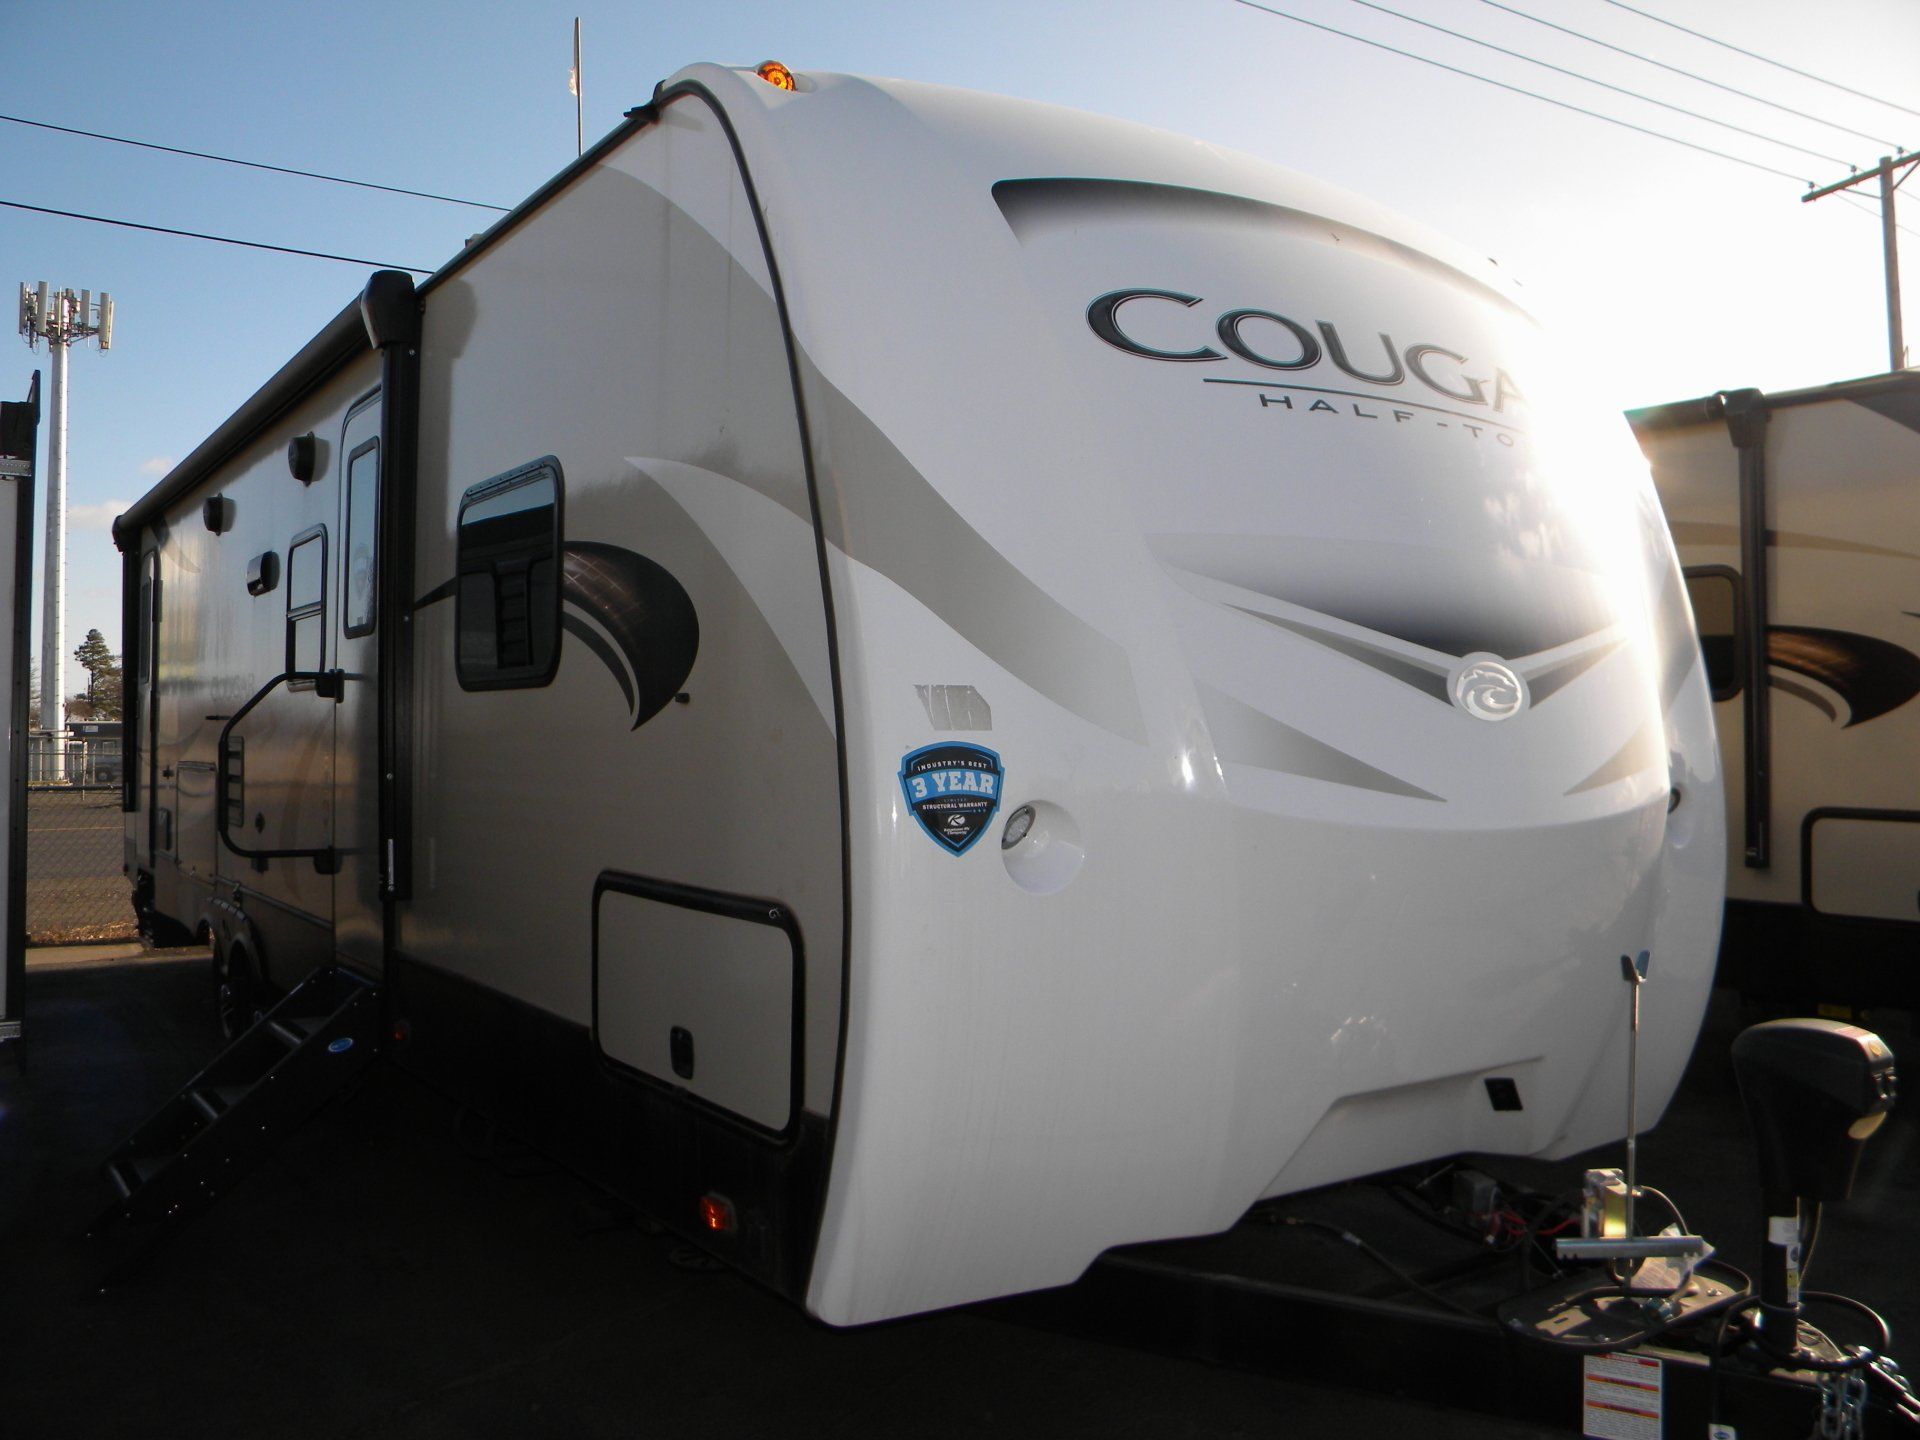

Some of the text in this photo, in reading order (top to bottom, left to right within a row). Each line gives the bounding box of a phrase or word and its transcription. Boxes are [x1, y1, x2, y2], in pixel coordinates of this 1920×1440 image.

[1085, 287, 1531, 413] COUGA
[1258, 392, 1515, 448] HALF-TO
[911, 771, 994, 798] 3 YEAR
[917, 760, 988, 772] INDUSTRY'S BEST
